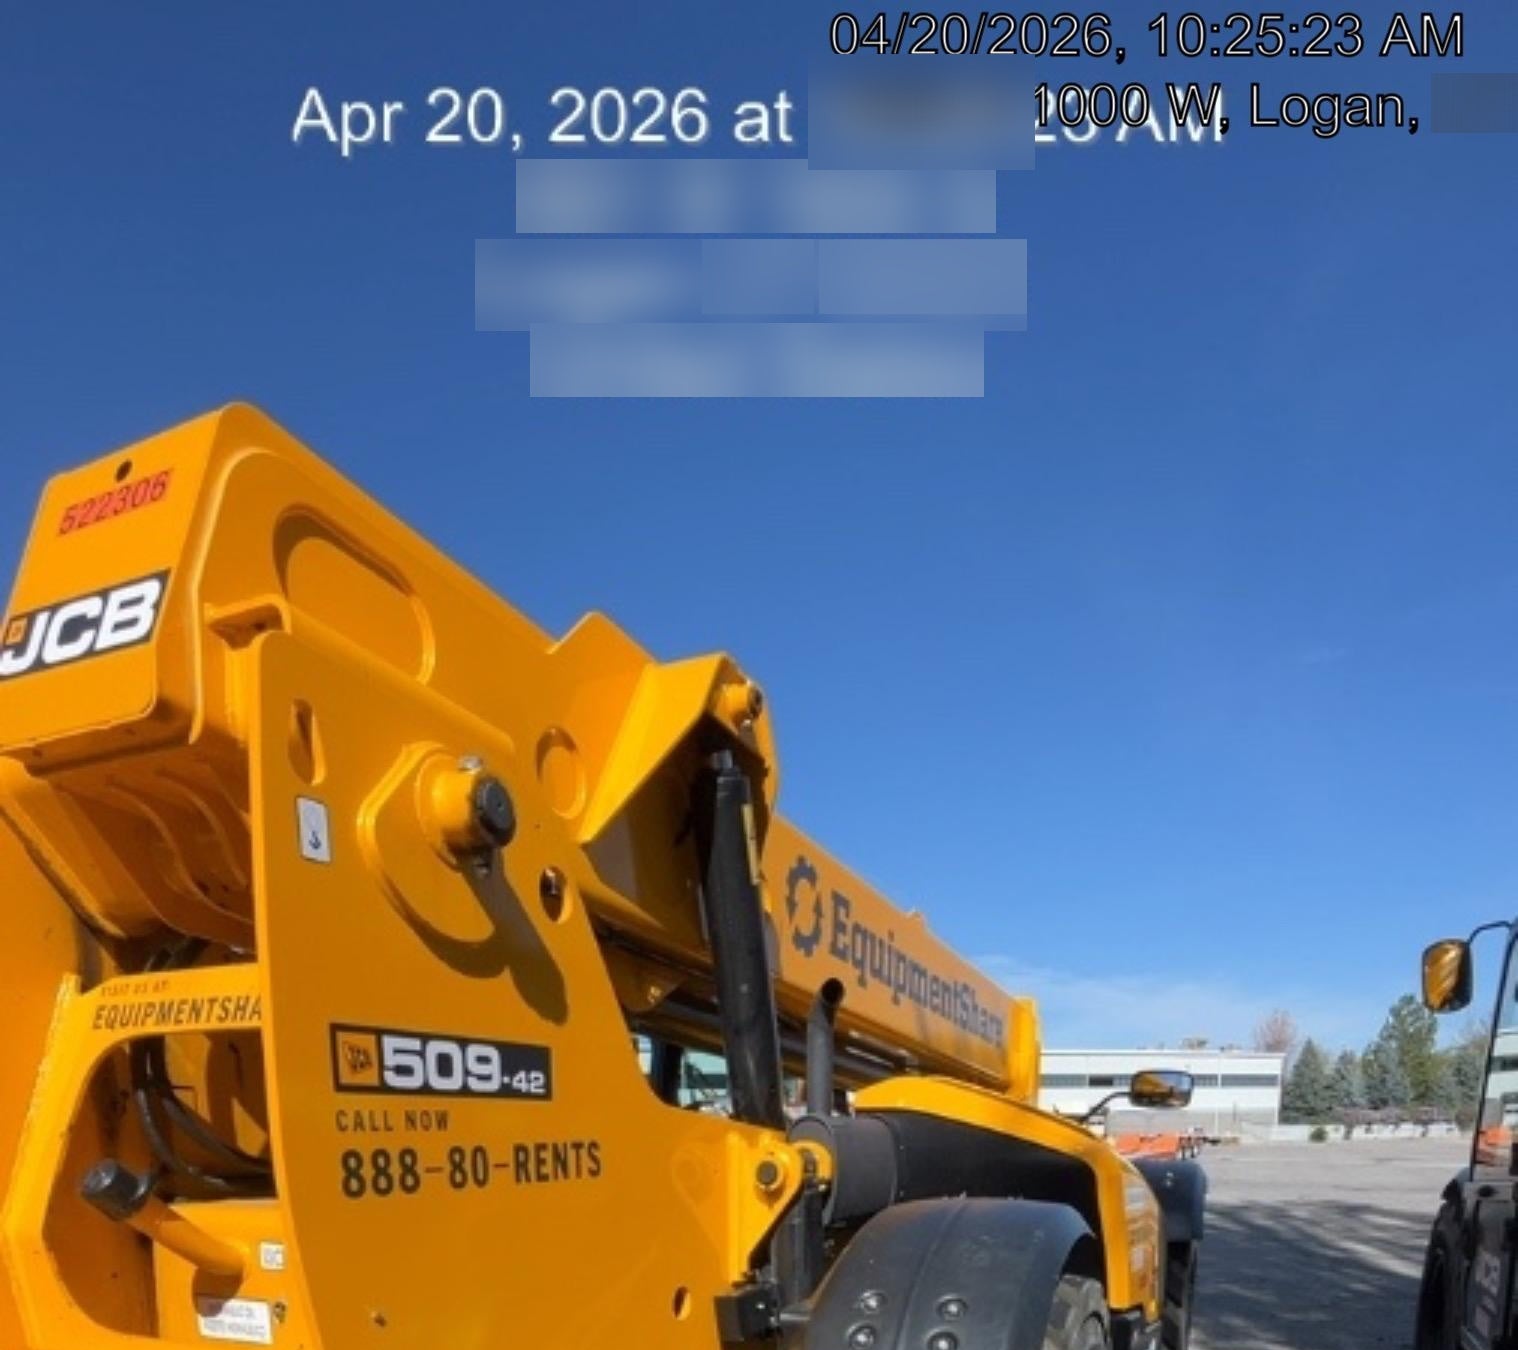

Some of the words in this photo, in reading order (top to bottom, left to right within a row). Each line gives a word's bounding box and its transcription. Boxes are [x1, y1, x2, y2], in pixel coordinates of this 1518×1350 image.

[57, 469, 174, 537] 522306
[0, 577, 162, 677] JCB
[830, 887, 1005, 1048] EquipmentShare
[335, 1109, 394, 1132] CALL
[404, 1109, 449, 1131] NOW
[341, 1140, 602, 1199] 888-80-RENTS
